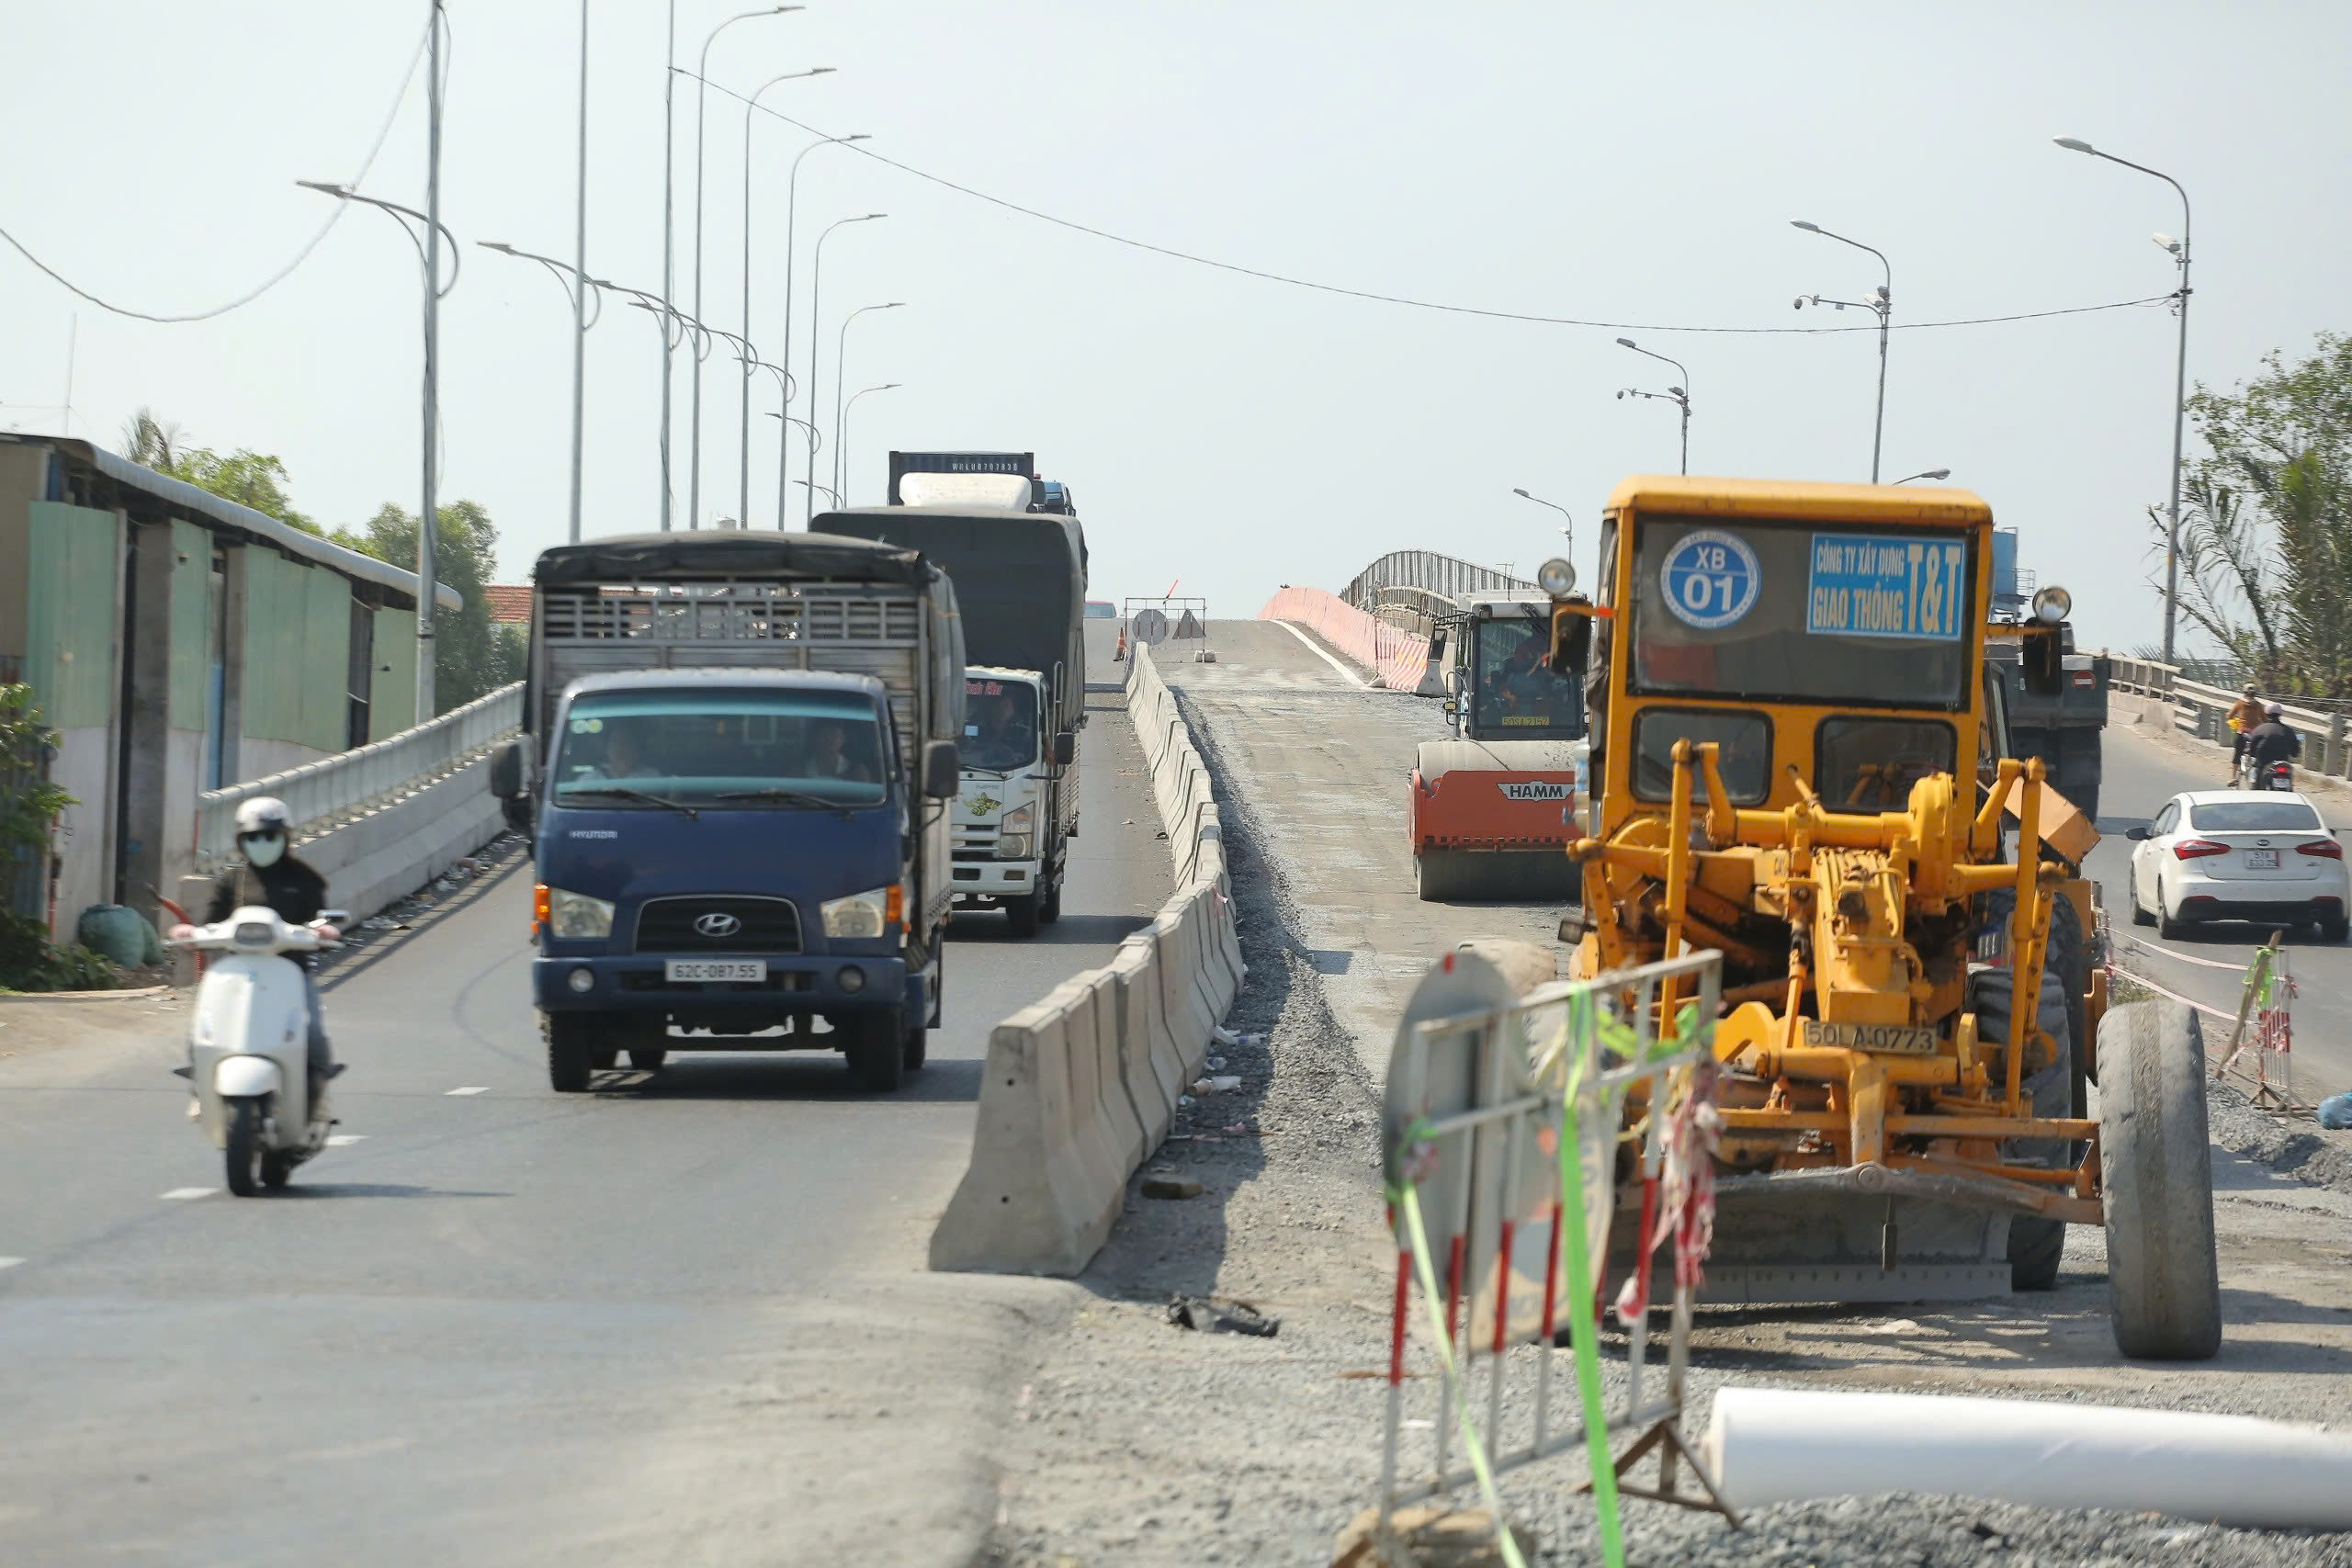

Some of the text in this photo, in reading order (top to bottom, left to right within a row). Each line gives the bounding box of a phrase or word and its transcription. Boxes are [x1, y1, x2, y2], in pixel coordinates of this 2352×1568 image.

[1696, 546, 1726, 570] XB
[1816, 539, 1843, 574] CÔNG
[1845, 546, 1857, 575] TY
[1683, 573, 1734, 612] 01
[1813, 581, 1904, 631] GIAO THÔNG
[1907, 544, 1962, 633] T&T
[1510, 785, 1564, 798] HAMM
[571, 830, 618, 839] HYUNDAI
